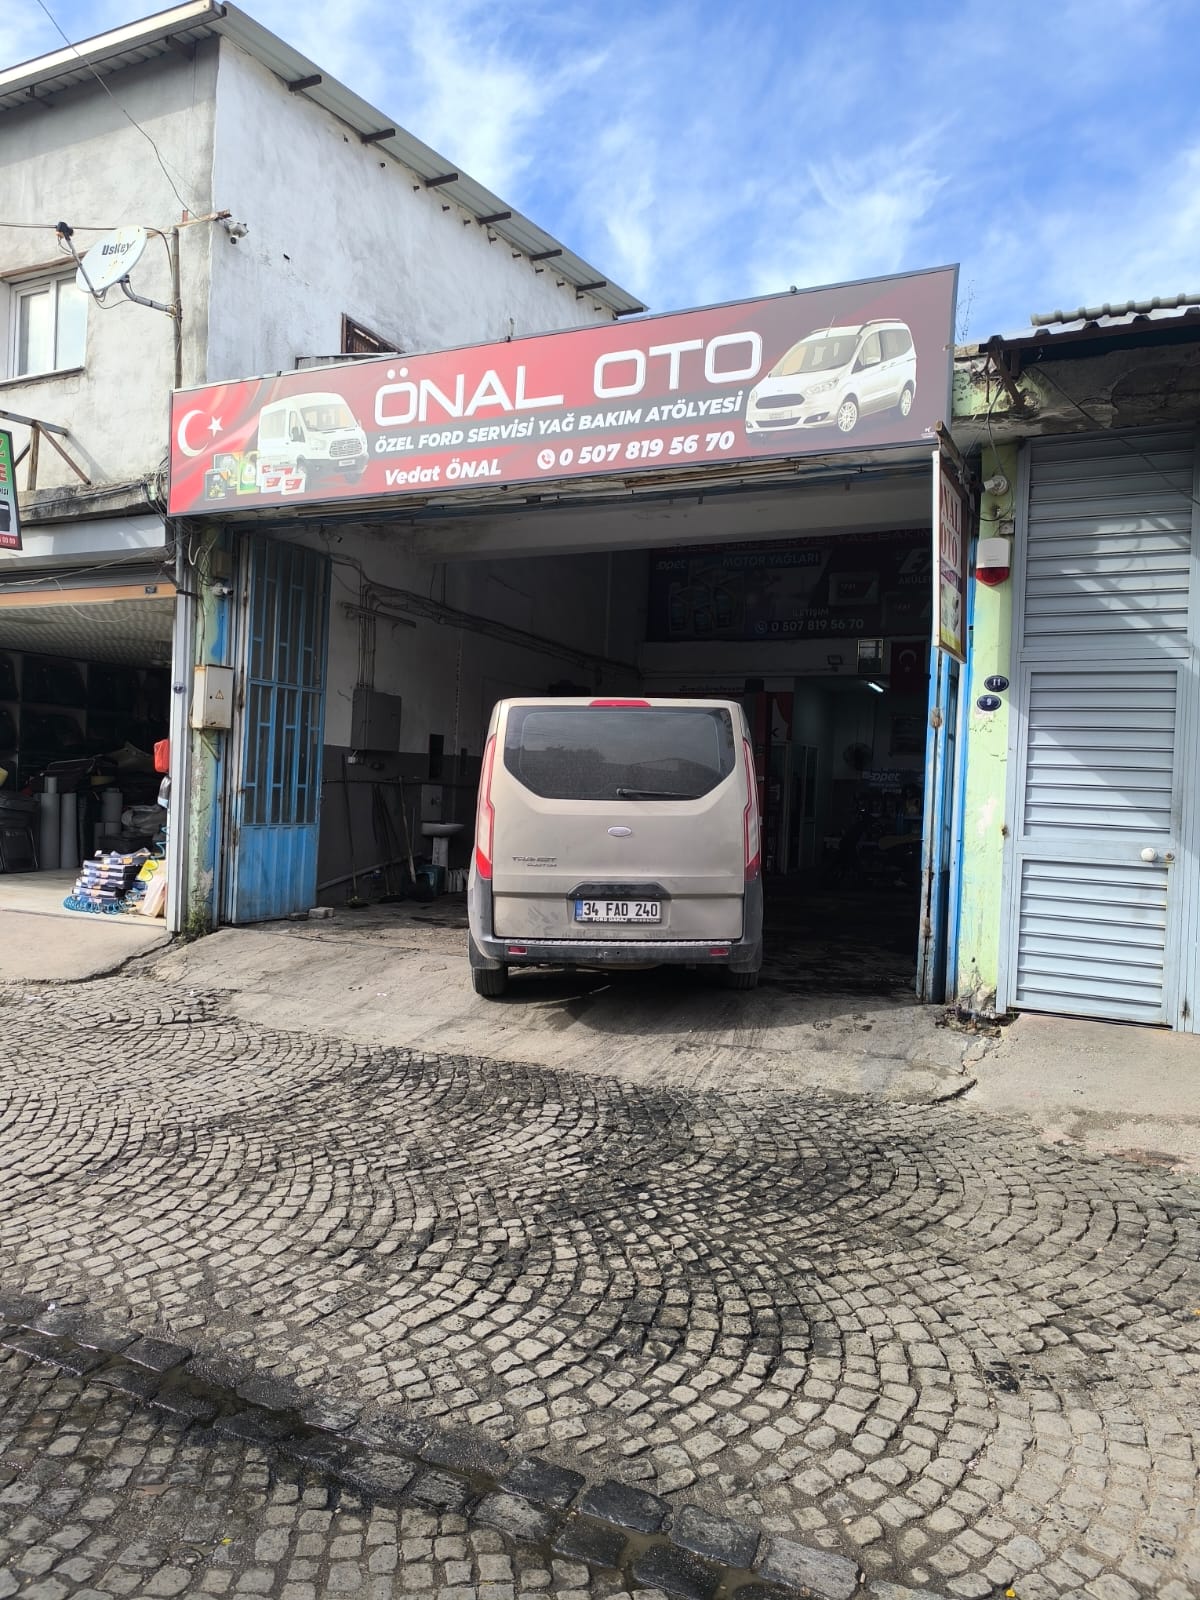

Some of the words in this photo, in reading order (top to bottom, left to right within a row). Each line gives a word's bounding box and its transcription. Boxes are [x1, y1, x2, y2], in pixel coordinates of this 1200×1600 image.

[374, 365, 564, 427] ÖNAL
[593, 331, 763, 399] OTO
[375, 435, 414, 453] ÖZEL
[418, 430, 464, 449] FORD
[467, 417, 535, 443] SERVİSİ
[538, 412, 576, 434] YAĞ
[578, 409, 642, 431] BAKIM
[645, 390, 744, 422] ATÖLYESİ
[559, 448, 573, 466] 0
[578, 443, 621, 464] 507
[625, 439, 664, 459] 819
[669, 434, 699, 455] 56
[705, 430, 735, 452] 70
[384, 465, 441, 486] Vedat
[445, 458, 502, 480] ÖNAL
[782, 620, 804, 632] 507
[807, 619, 828, 631] 819
[831, 618, 846, 630] 56
[848, 617, 864, 629] 70
[583, 902, 599, 916] 34
[606, 902, 629, 917] FAD
[635, 903, 658, 917] 240
